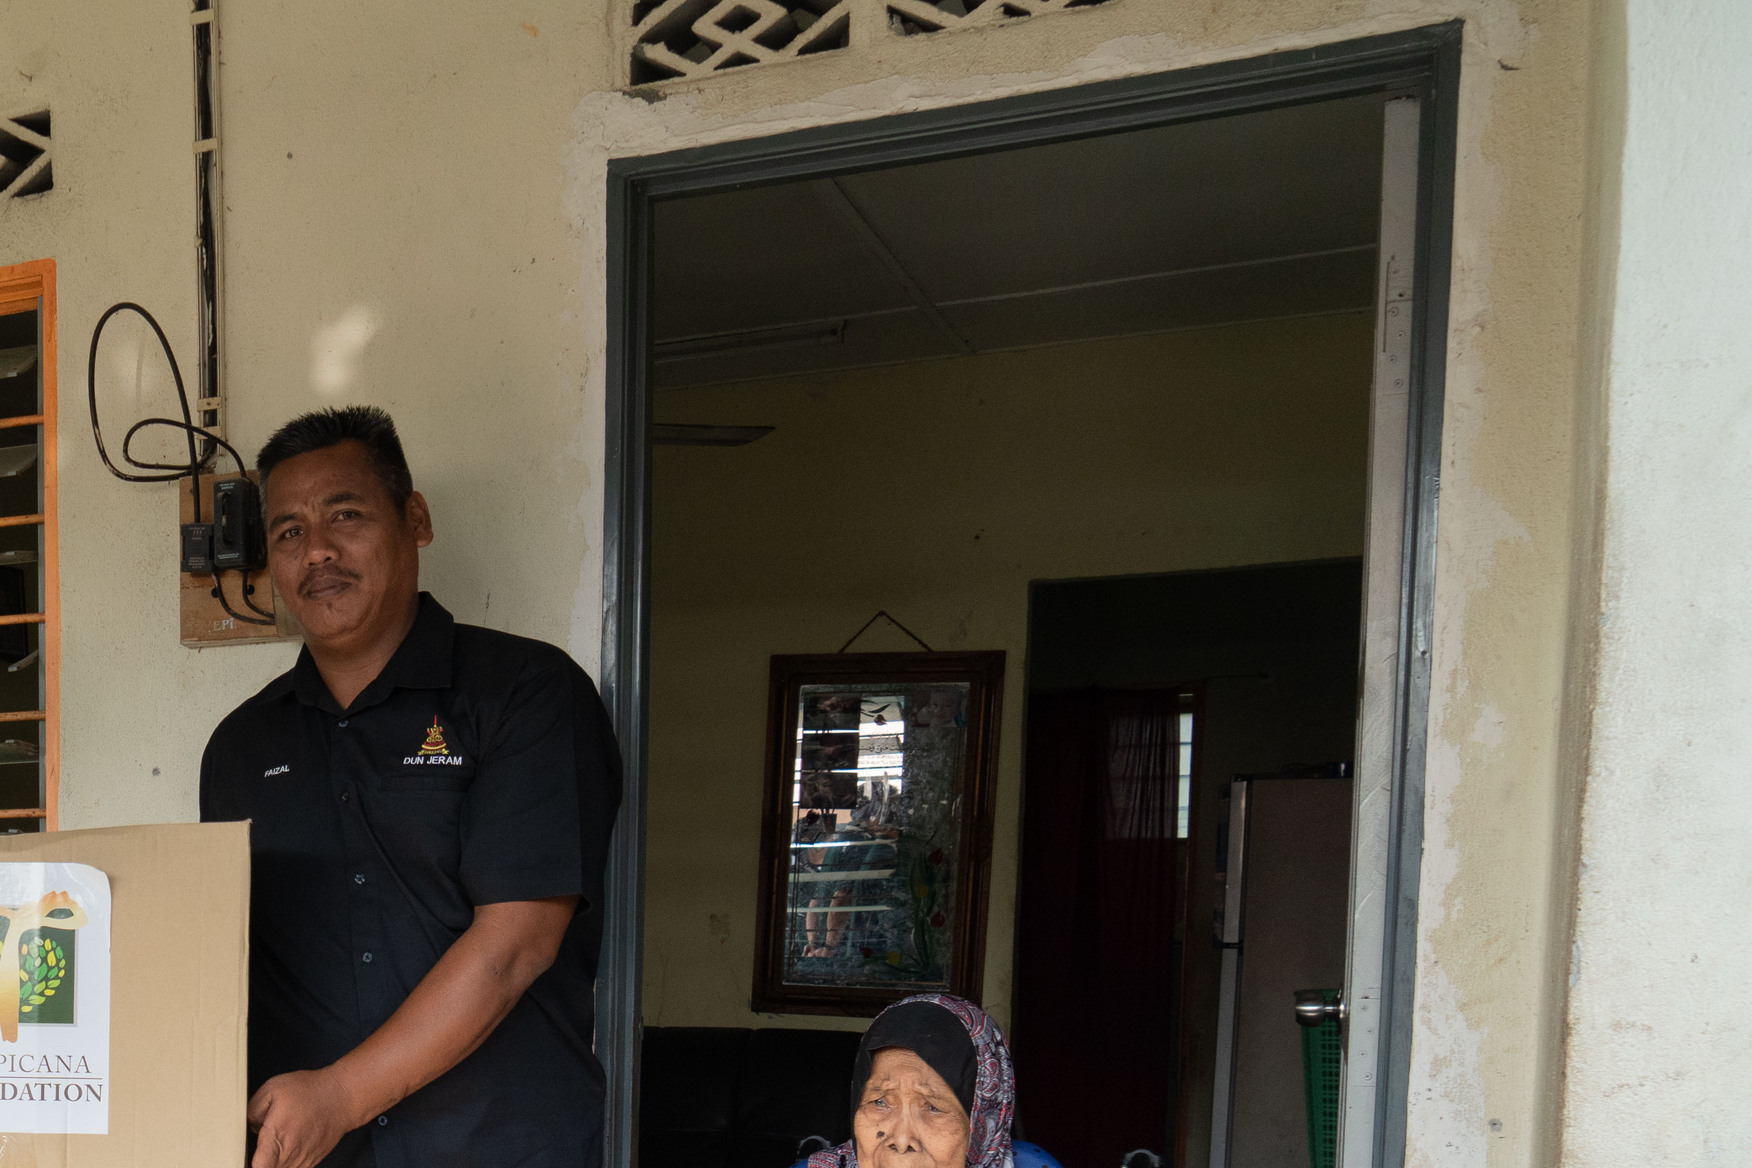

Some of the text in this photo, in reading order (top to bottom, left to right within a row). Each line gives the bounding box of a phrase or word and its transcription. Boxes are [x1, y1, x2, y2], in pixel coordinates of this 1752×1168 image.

[403, 755, 463, 766] DUN JERAM
[264, 764, 290, 778] FAIZAL
